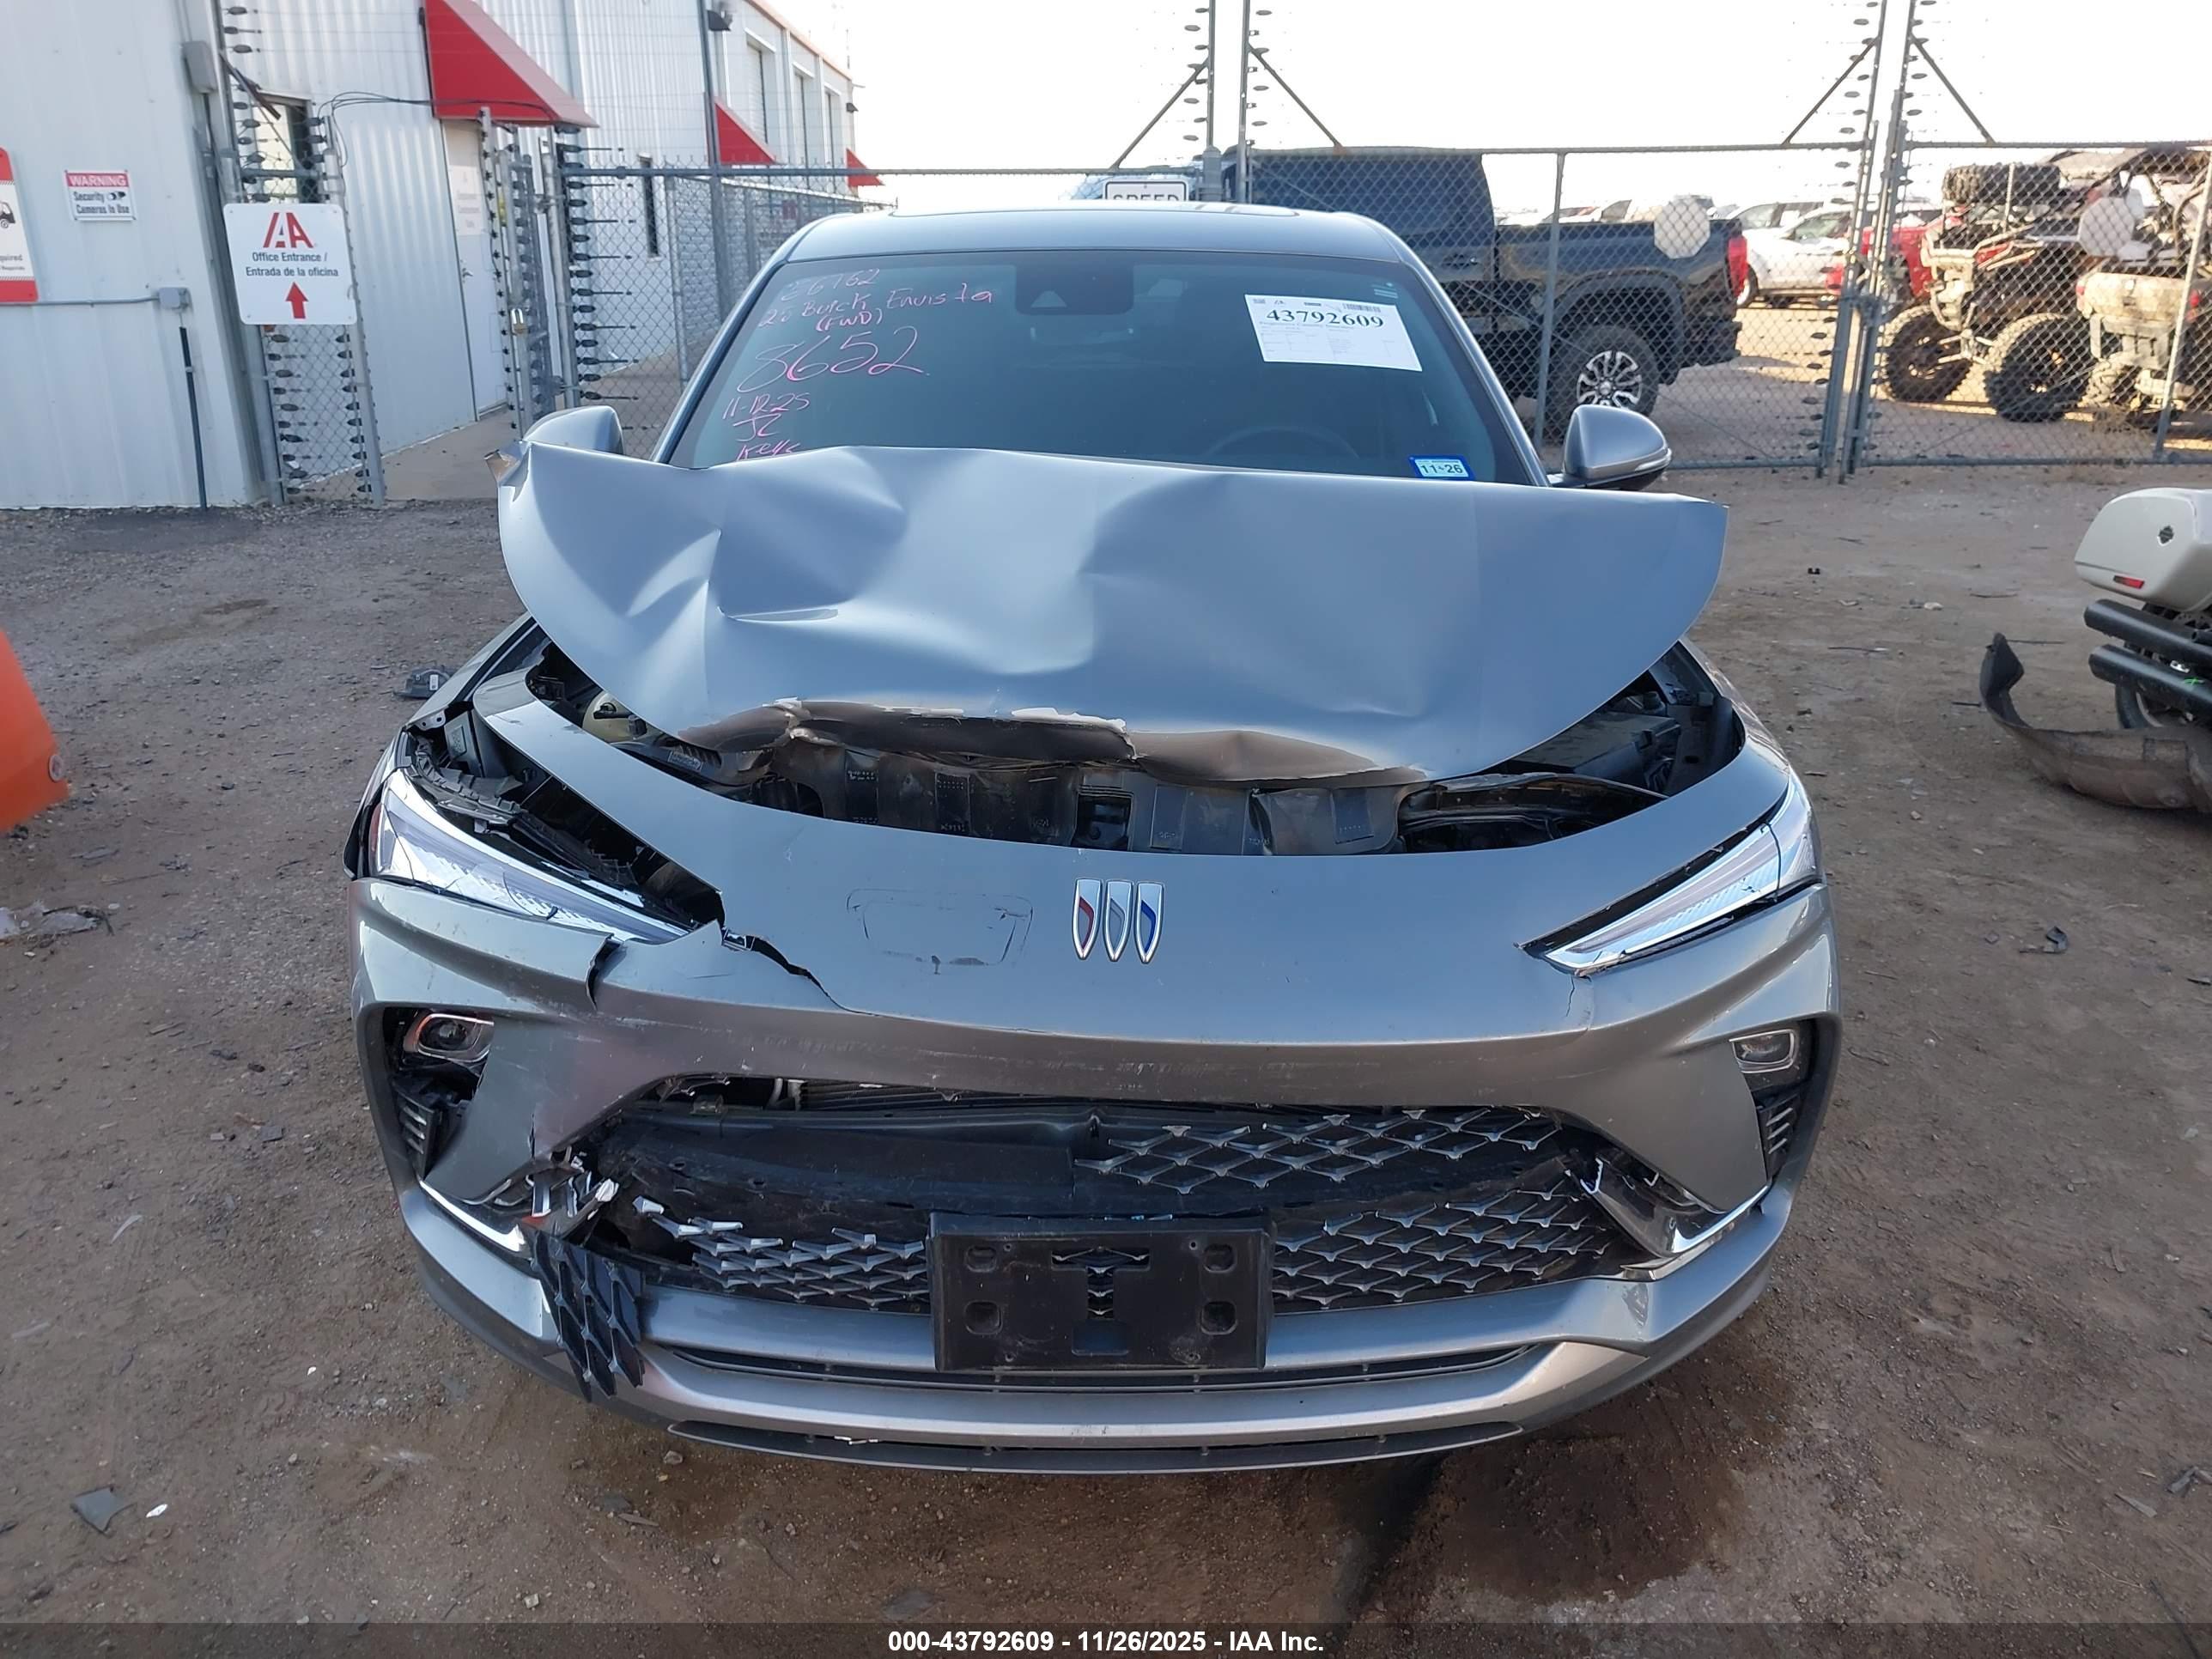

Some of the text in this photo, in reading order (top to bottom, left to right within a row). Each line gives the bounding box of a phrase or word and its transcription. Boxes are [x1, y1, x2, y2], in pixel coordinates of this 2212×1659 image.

[70, 174, 128, 186] WARNING
[74, 191, 105, 204] Security
[76, 204, 130, 214] Cameras In Use
[252, 252, 279, 262] Office
[281, 252, 322, 262] Entrance
[246, 266, 339, 276] Entrada de la oficina
[802, 293, 868, 317] Buick
[815, 307, 884, 332] (FWD)
[1266, 308, 1385, 328] 43792609
[737, 325, 924, 393] 8652
